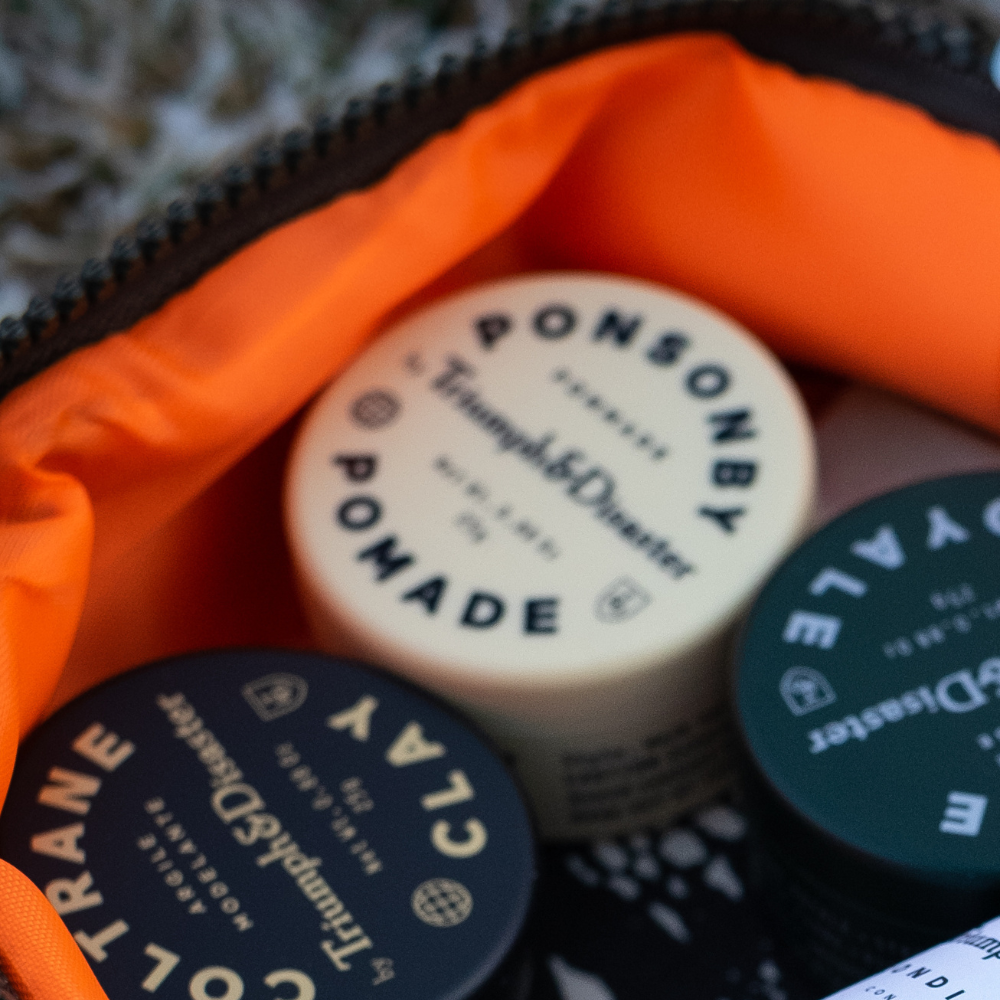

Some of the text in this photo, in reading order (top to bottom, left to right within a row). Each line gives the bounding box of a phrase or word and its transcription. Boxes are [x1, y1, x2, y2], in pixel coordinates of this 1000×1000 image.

[430, 352, 695, 581] Triumph&Disaster
[474, 303, 758, 535] PONSONBY
[331, 450, 561, 636] POMADE
[142, 795, 256, 934] MODELANTE
[156, 691, 374, 973] Triumph&Disaster
[326, 694, 489, 860] CLAY
[136, 831, 209, 917] ARGILE
